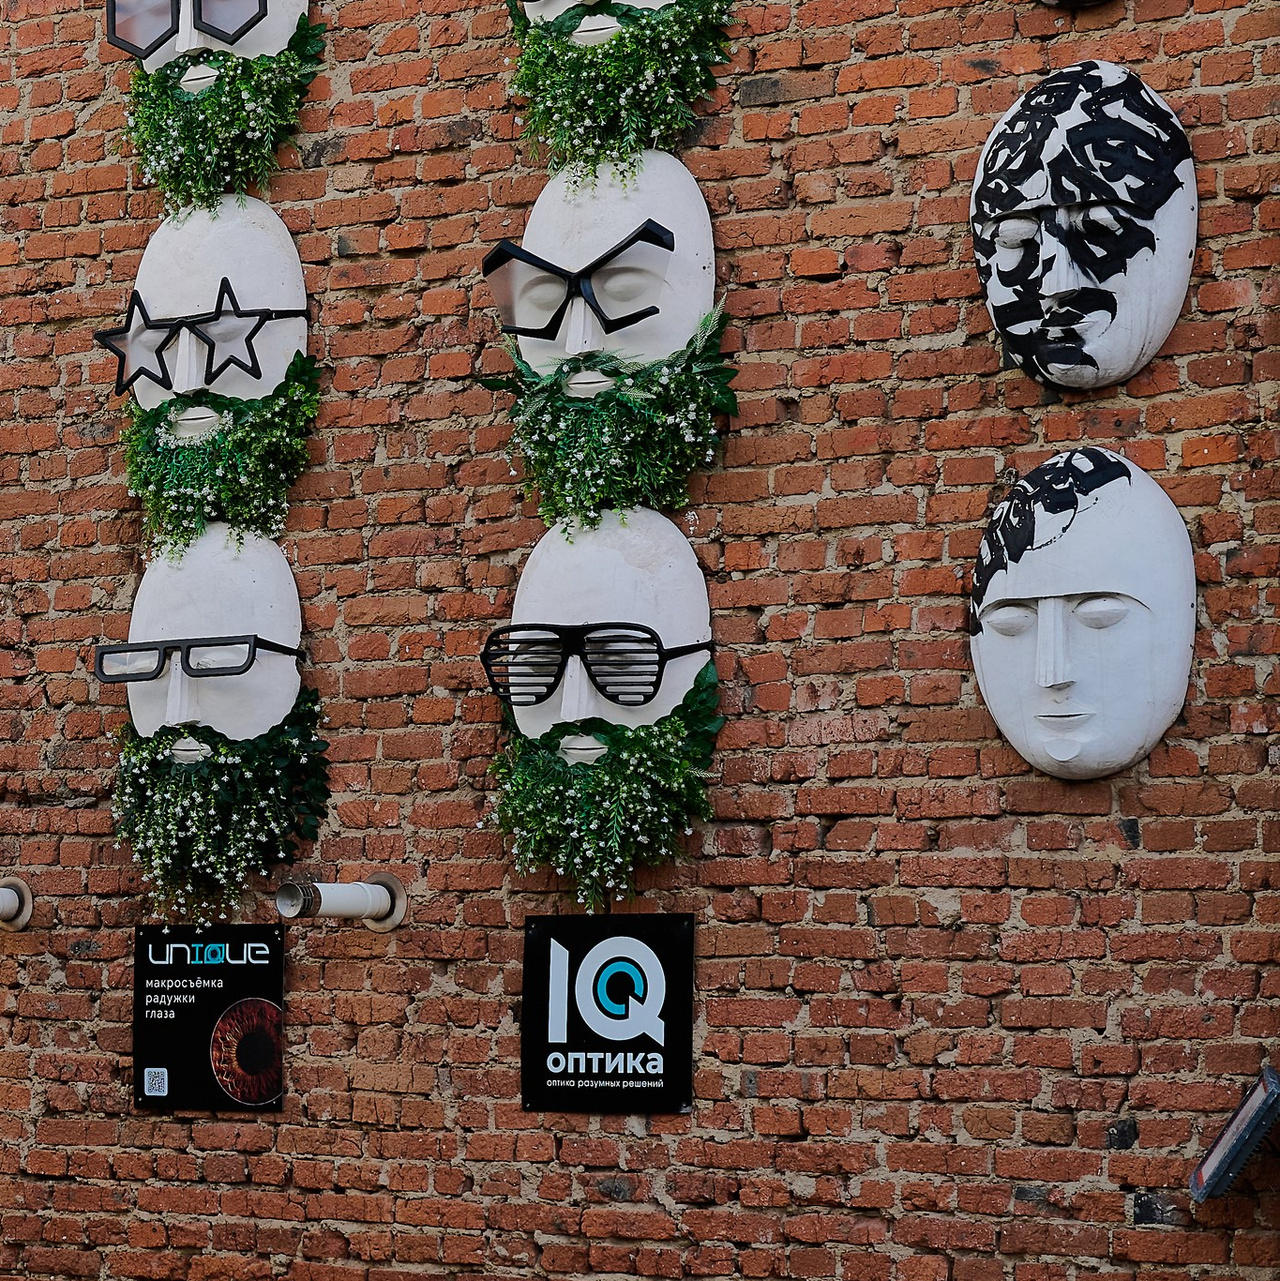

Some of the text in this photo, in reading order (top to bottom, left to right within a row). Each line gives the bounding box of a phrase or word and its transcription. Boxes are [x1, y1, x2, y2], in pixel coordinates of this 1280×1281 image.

[145, 976, 224, 990] макросъёмка
[548, 936, 666, 1047] IQ
[145, 994, 196, 1006] радужки
[145, 1009, 176, 1019] глаза
[546, 1052, 664, 1074] оптика
[546, 1079, 664, 1089] оптика разумных решений
